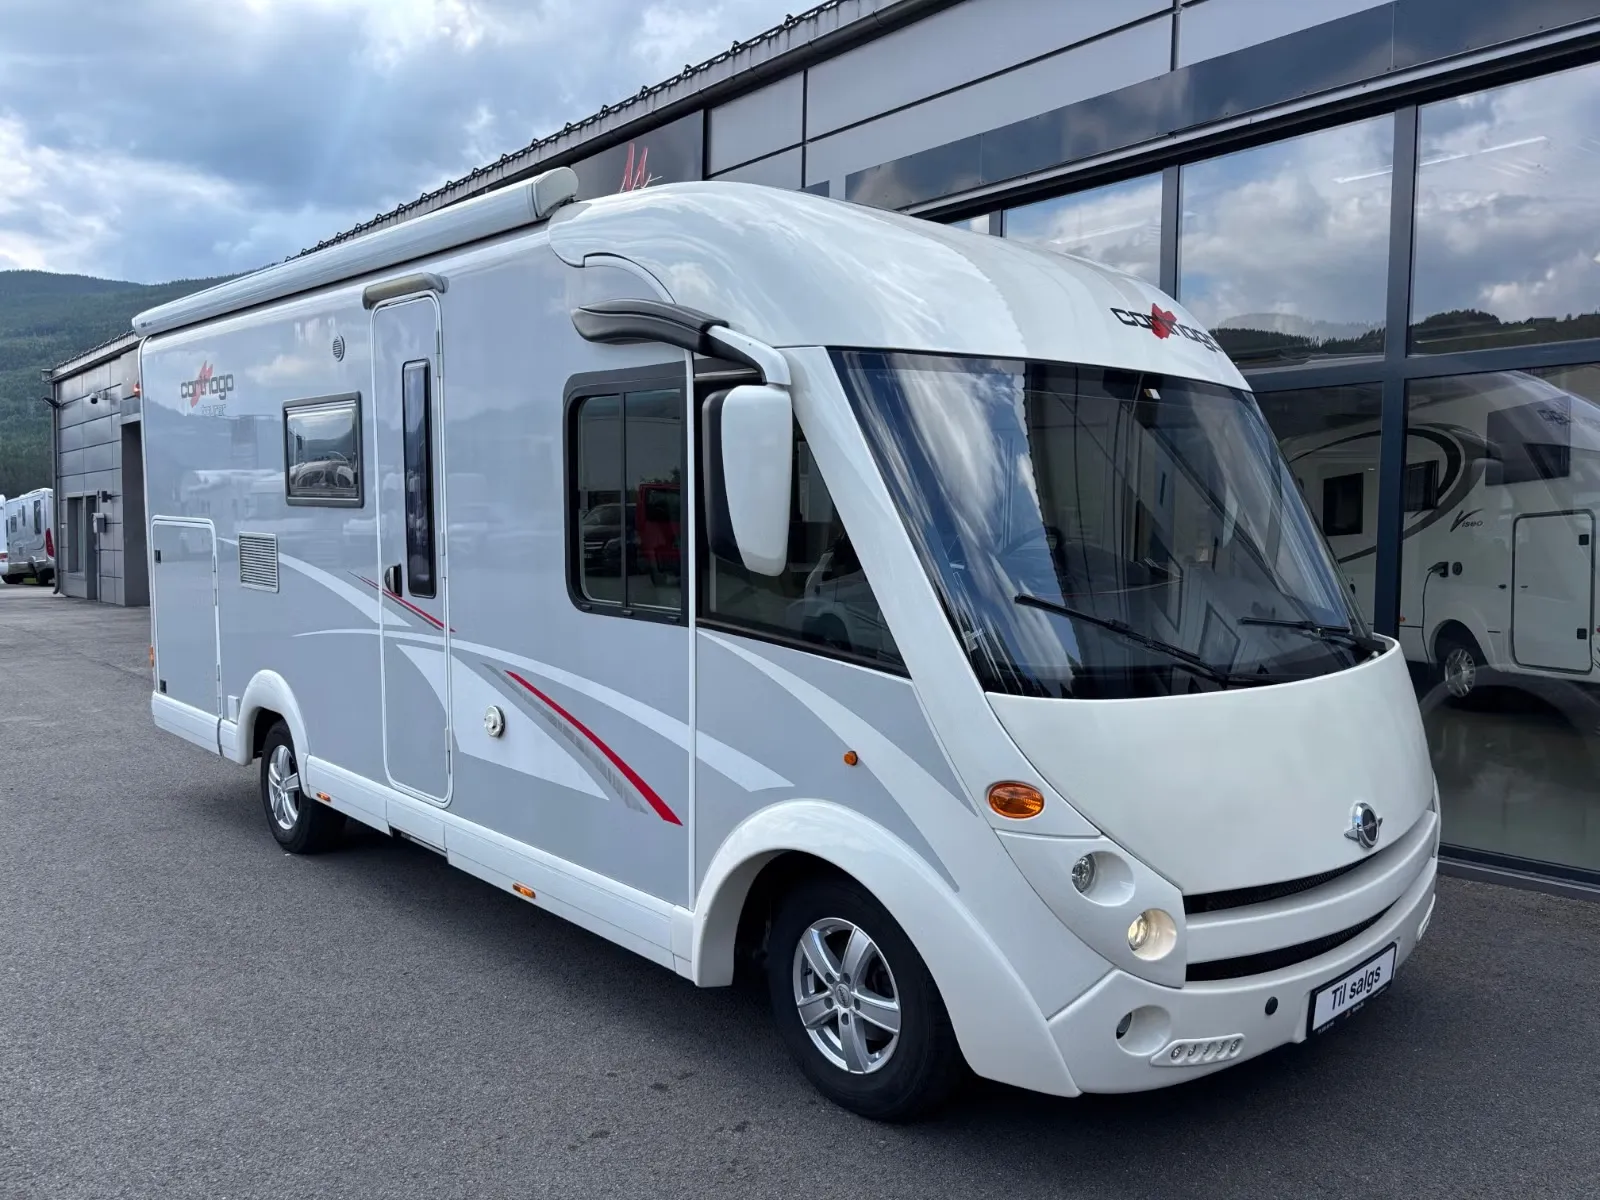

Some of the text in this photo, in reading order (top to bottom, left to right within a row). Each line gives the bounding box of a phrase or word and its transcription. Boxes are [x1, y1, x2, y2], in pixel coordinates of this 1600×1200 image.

[180, 373, 234, 401] carthago
[1331, 966, 1381, 1011] Til salgs
